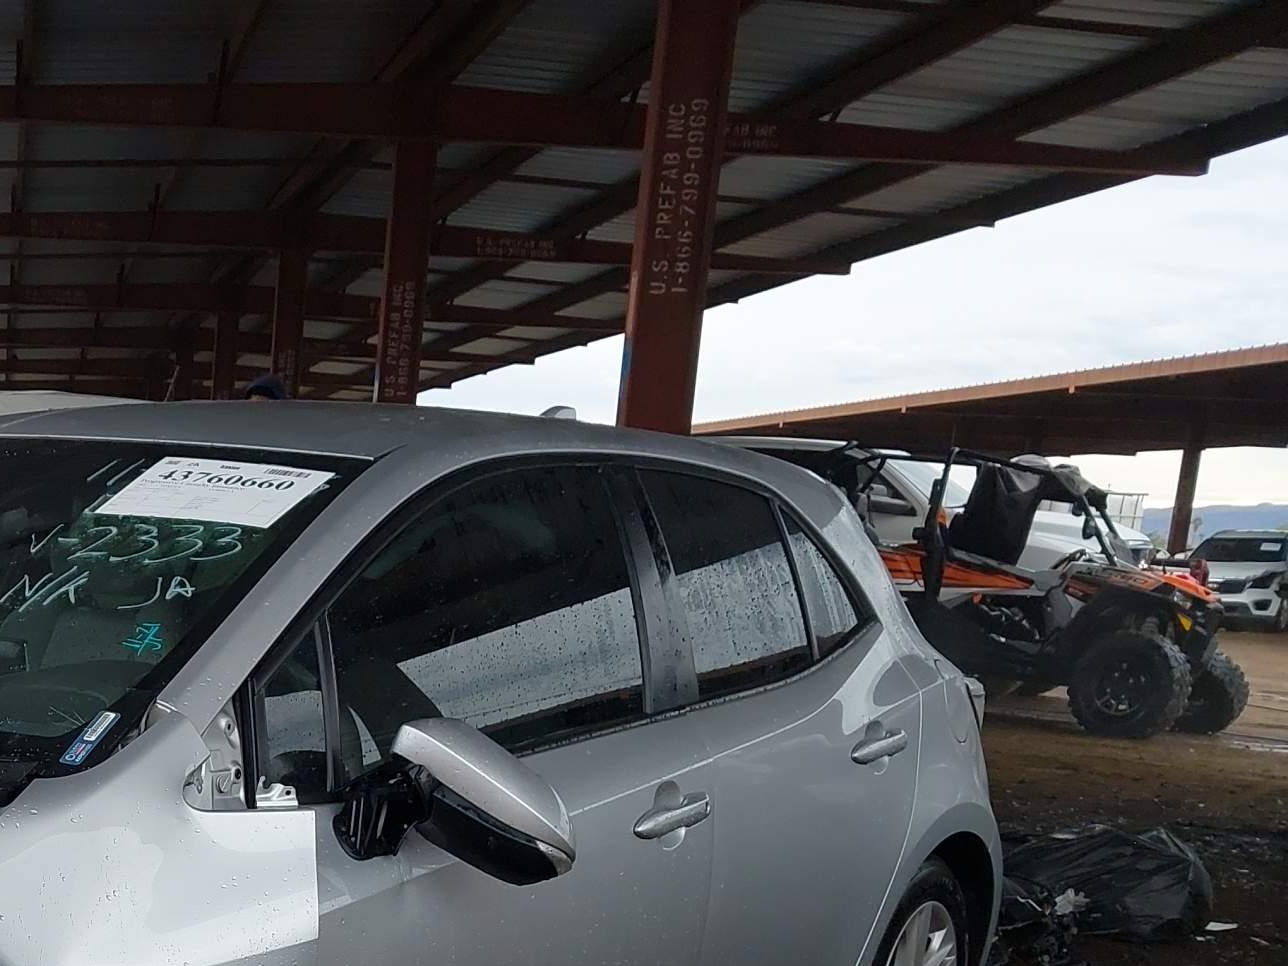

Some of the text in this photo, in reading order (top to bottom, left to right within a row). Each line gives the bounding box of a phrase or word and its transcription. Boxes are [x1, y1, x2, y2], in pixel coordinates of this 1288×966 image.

[665, 103, 686, 139] INC
[655, 152, 680, 239] PREFAB
[671, 99, 709, 293] 1-866-799-0969
[158, 469, 295, 491] 43760660
